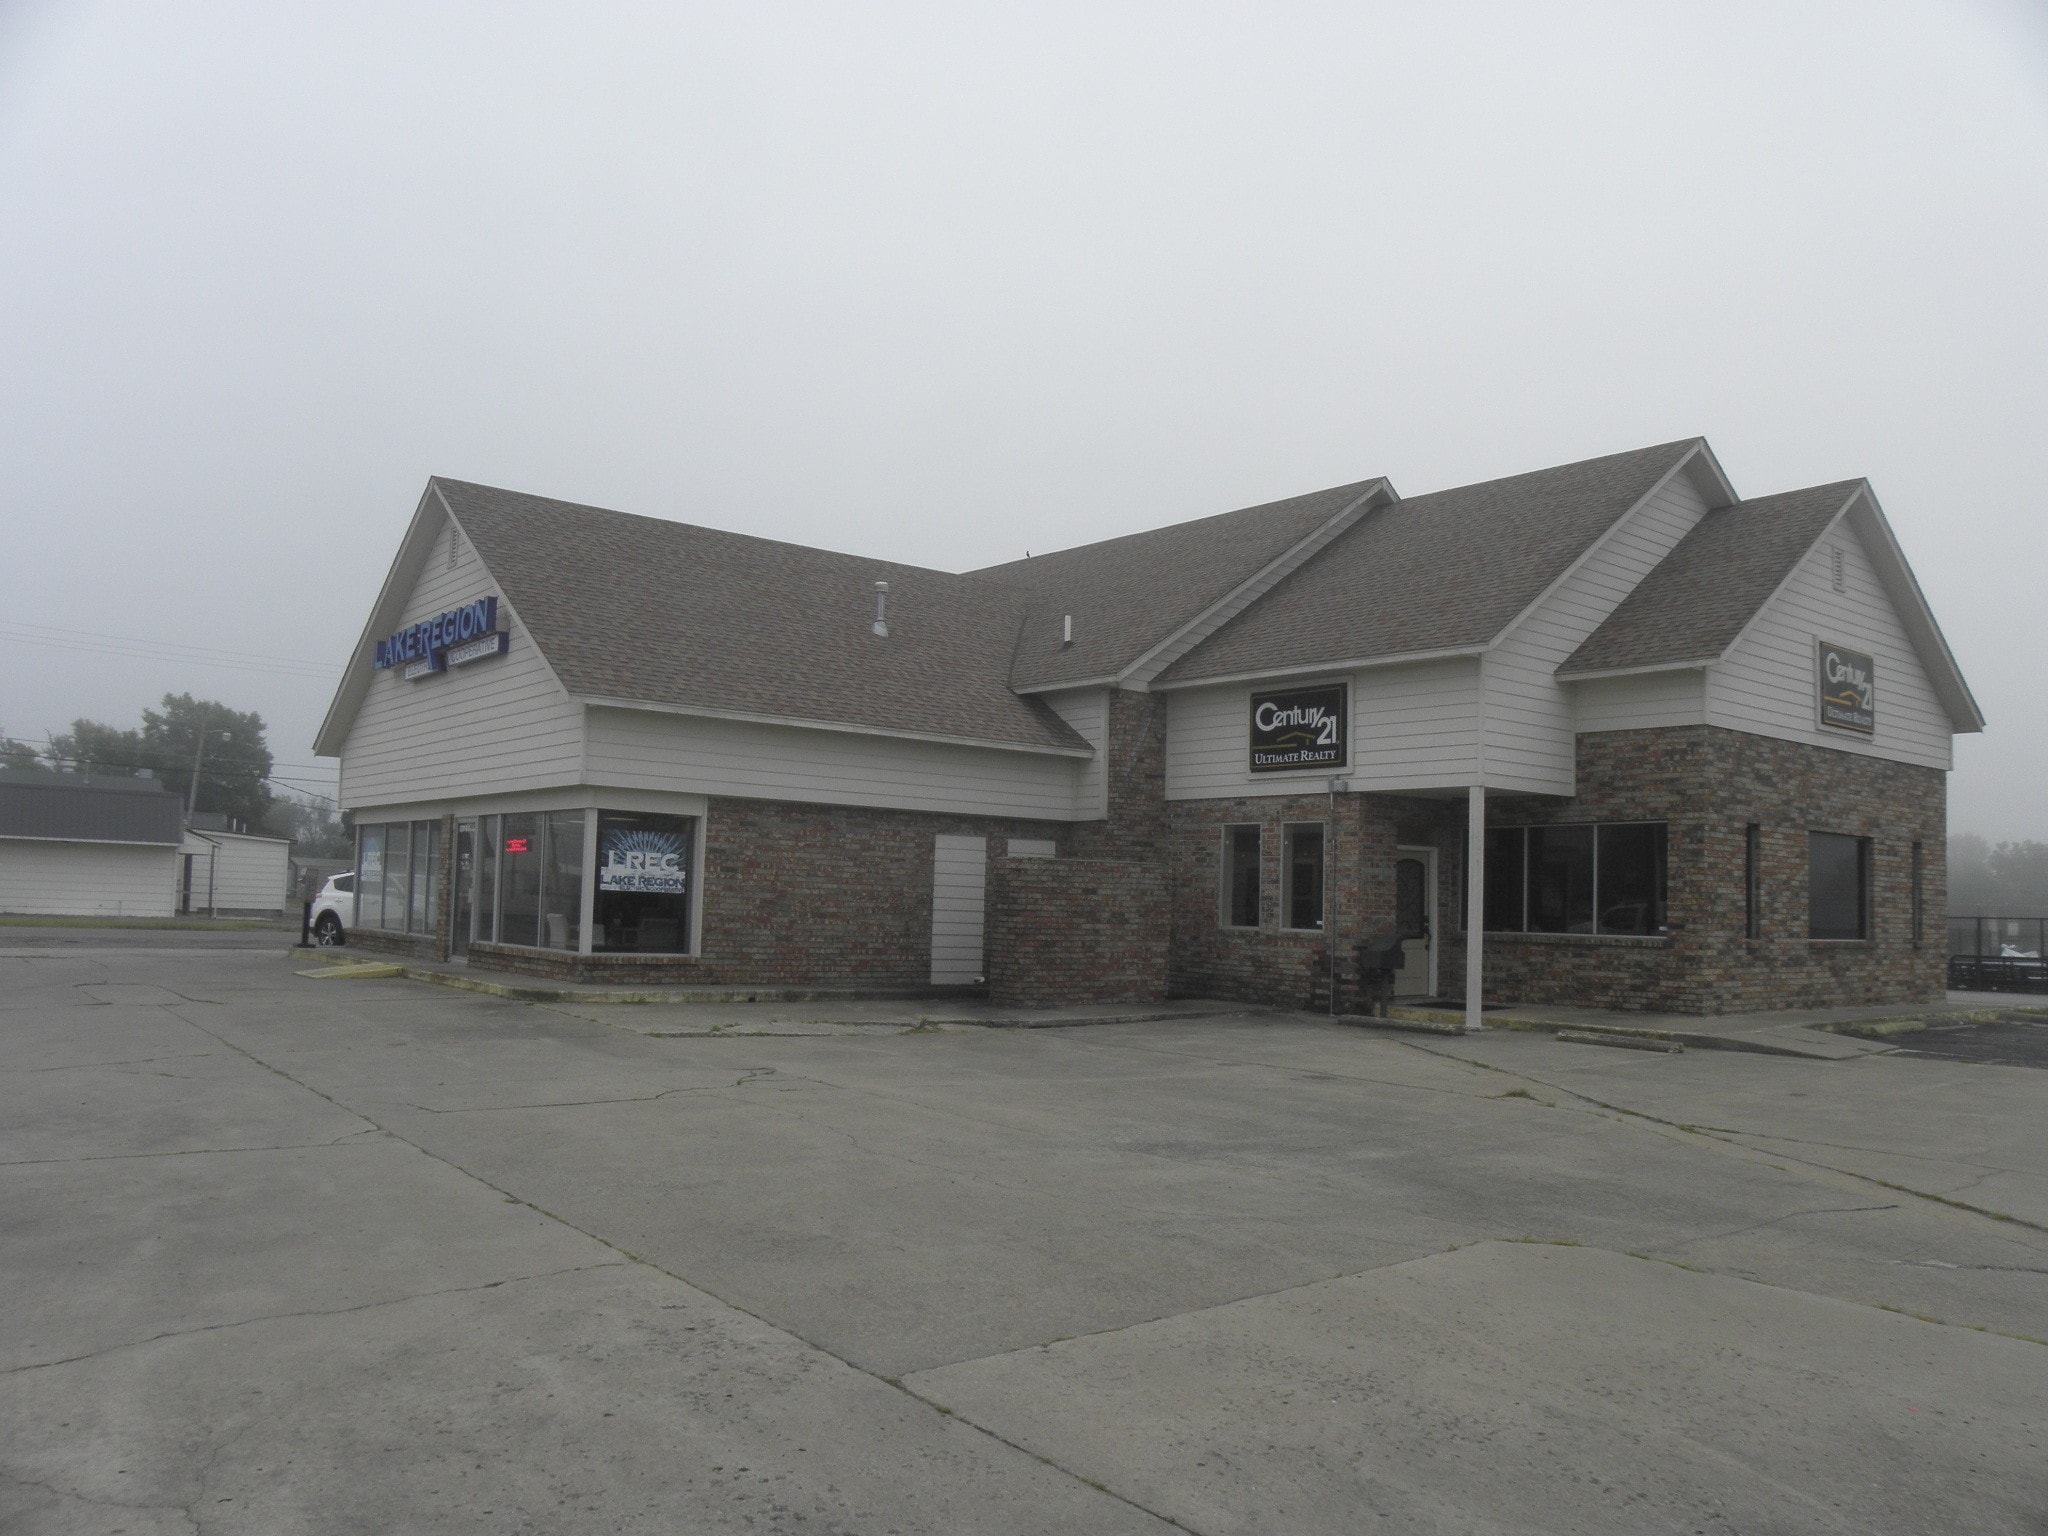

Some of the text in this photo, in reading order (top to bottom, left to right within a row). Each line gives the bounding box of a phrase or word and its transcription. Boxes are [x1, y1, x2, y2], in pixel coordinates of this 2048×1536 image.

[420, 598, 489, 670] REGION
[1255, 702, 1325, 731] Century
[1316, 715, 1337, 744] 21
[1255, 750, 1336, 764] ULTIMATE REALTY
[608, 850, 680, 871] LREC
[601, 874, 636, 886] LAKE
[638, 875, 684, 889] REGION
